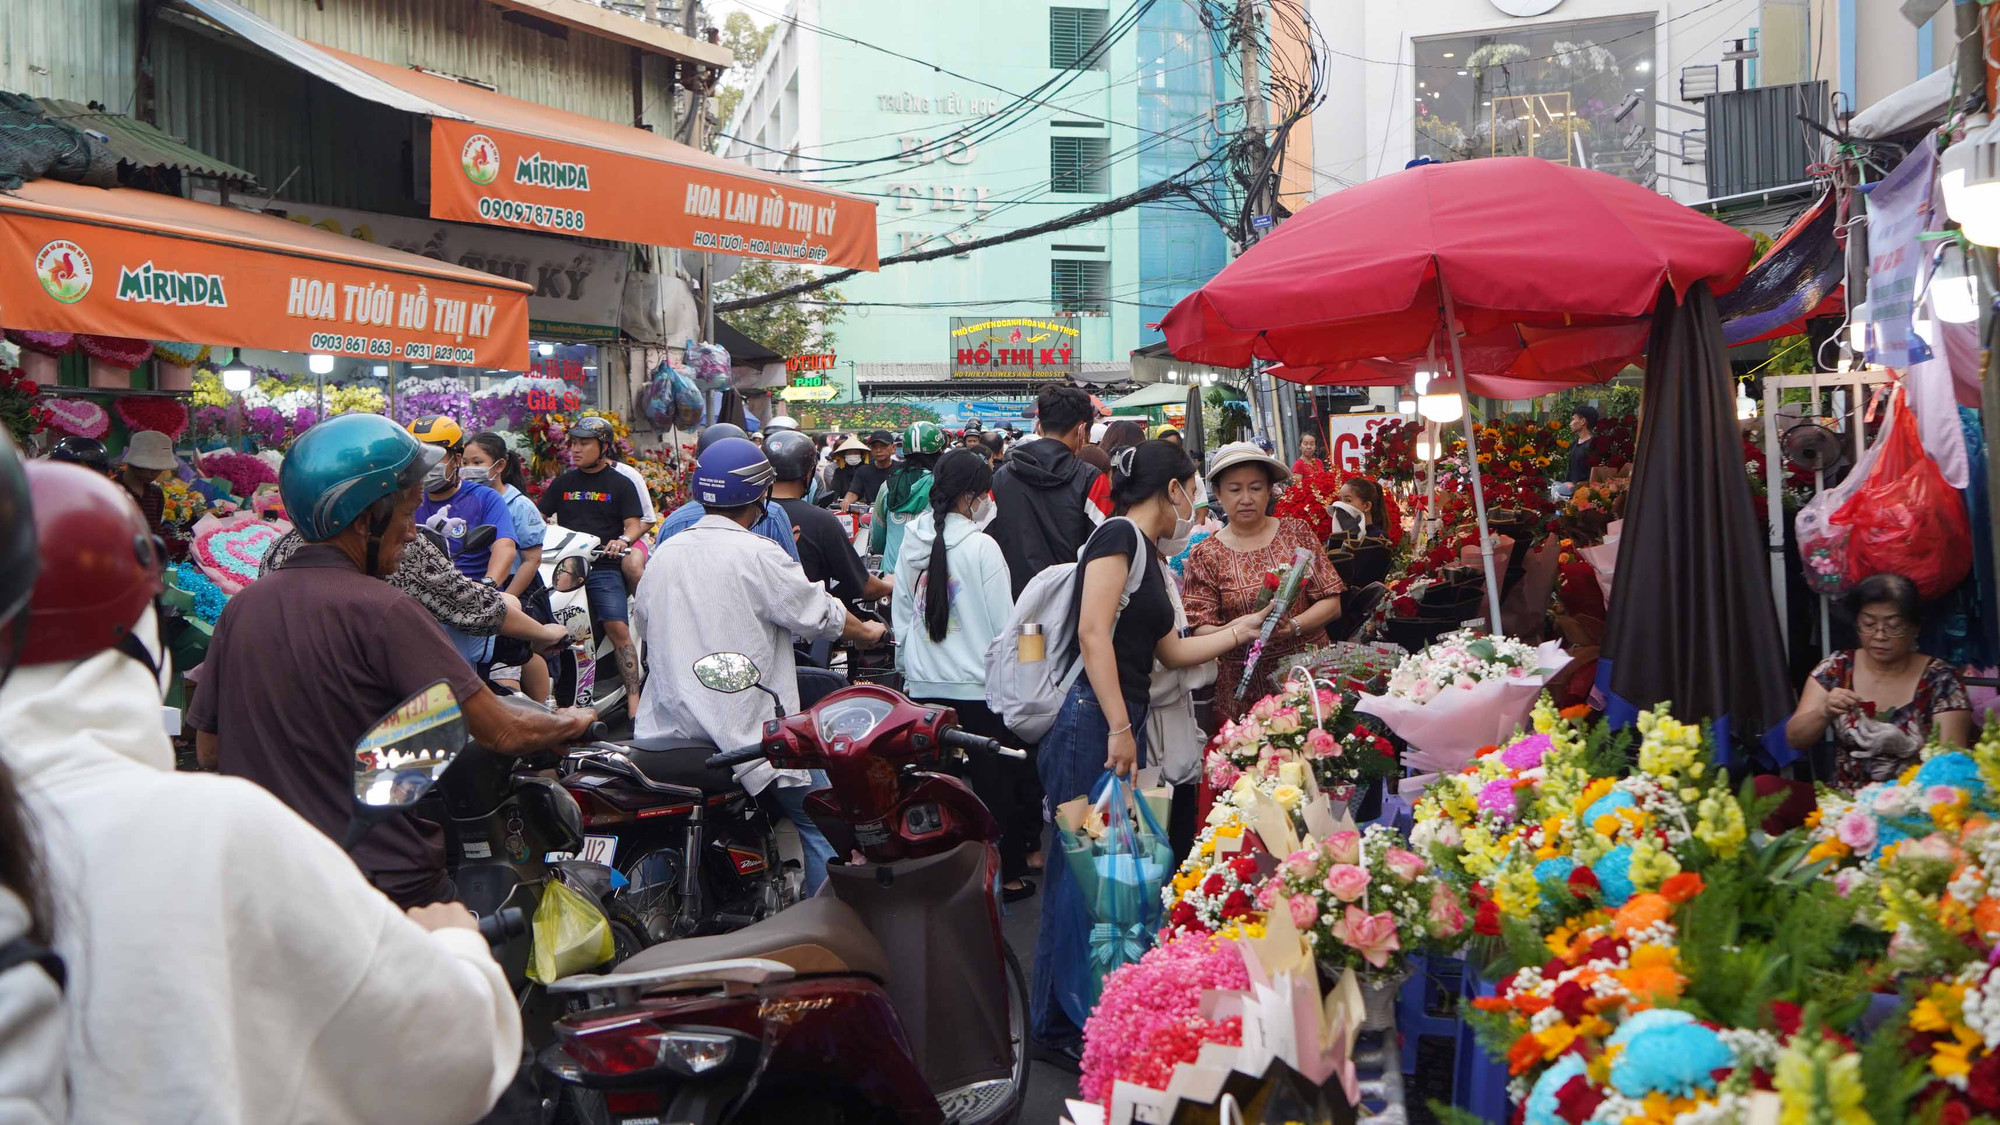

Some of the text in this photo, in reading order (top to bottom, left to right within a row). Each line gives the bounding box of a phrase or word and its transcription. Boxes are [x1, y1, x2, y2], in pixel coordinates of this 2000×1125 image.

[479, 197, 585, 231] 0909787588
[684, 183, 837, 239] HOA LAN HỒ THỊ KỶ
[694, 231, 716, 247] HOA
[720, 234, 742, 250] TƯƠI
[750, 239, 770, 254] HOA
[772, 242, 790, 256] LAN
[793, 240, 806, 258] HỒ
[807, 245, 827, 264] ĐIỆP
[288, 277, 496, 343] HOA TƯƠI HỒ THỊ KỶ
[997, 319, 1020, 328] DOANH
[1022, 318, 1036, 327] HOA
[311, 332, 343, 352] 0903
[345, 336, 366, 353] 861
[370, 338, 392, 355] 863
[404, 343, 431, 360] 0931
[434, 346, 453, 361] 823
[454, 348, 474, 363] 004
[998, 349, 1033, 370] THỊ
[1040, 342, 1073, 365] KỶ
[527, 388, 580, 411] Giá Sỉ
